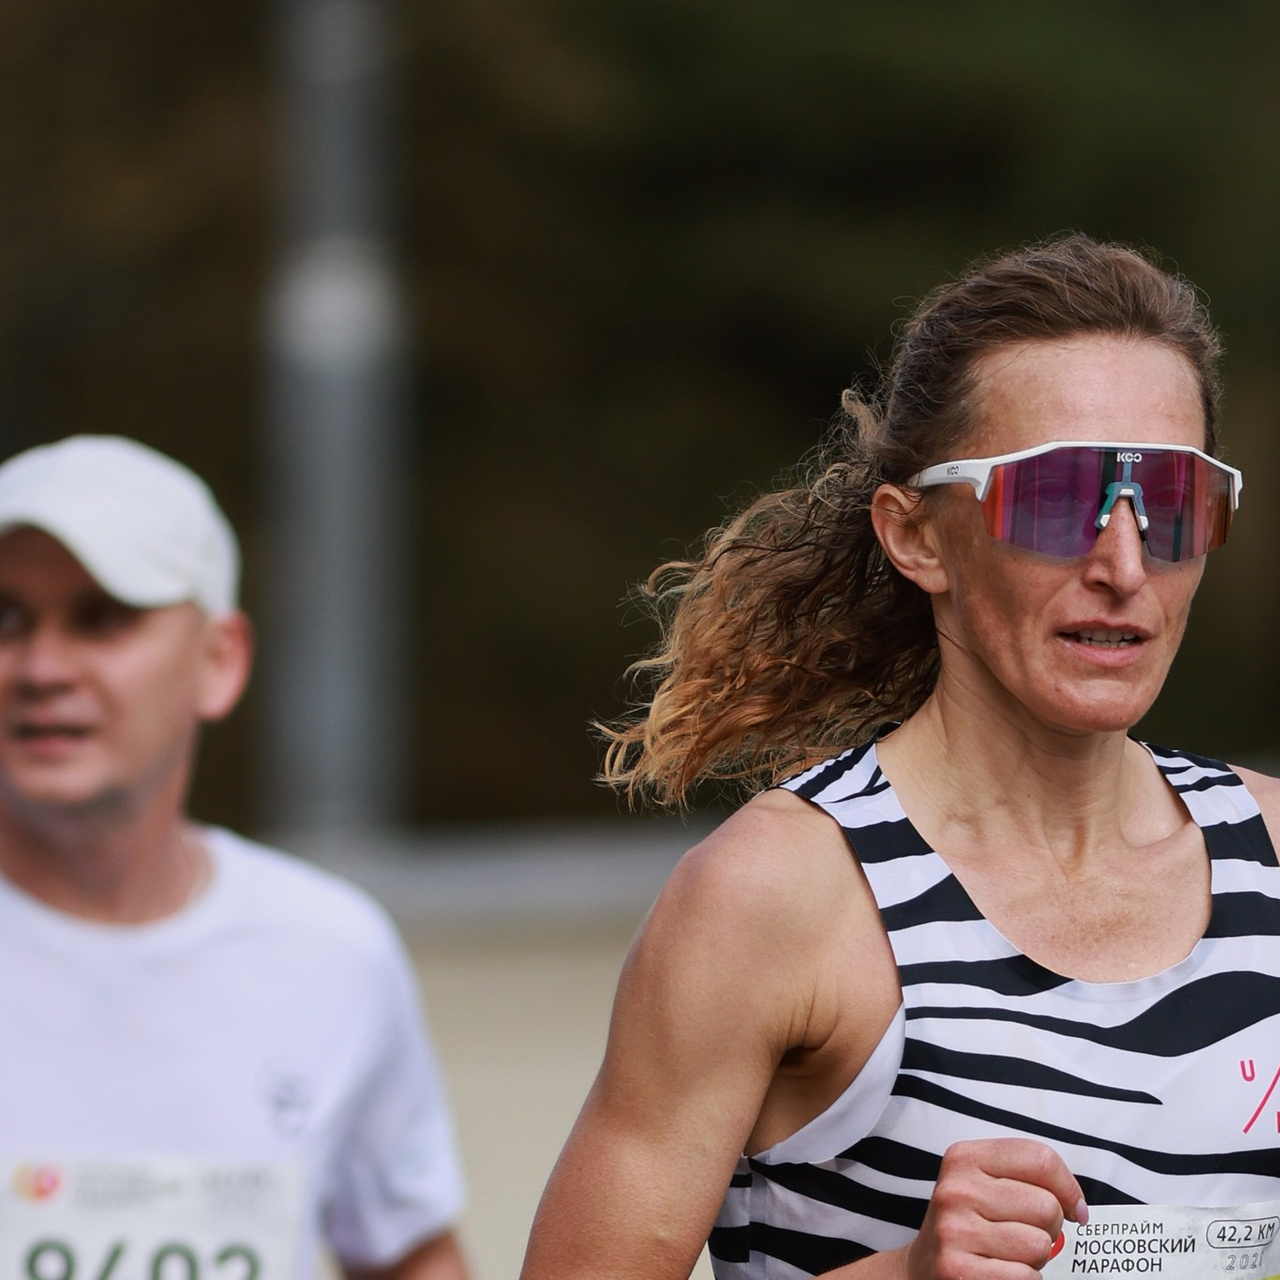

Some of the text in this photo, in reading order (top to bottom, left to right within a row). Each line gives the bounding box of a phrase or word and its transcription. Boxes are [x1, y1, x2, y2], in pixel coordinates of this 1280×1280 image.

[1116, 452, 1142, 463] KOO
[1076, 1220, 1164, 1236] СБЕРПРАЙМ
[1216, 1225, 1252, 1244] 42,2
[1073, 1235, 1196, 1255] МОСКОВСКИЙ
[1071, 1256, 1163, 1274] МАРАФОН
[1225, 1250, 1264, 1271] 202
